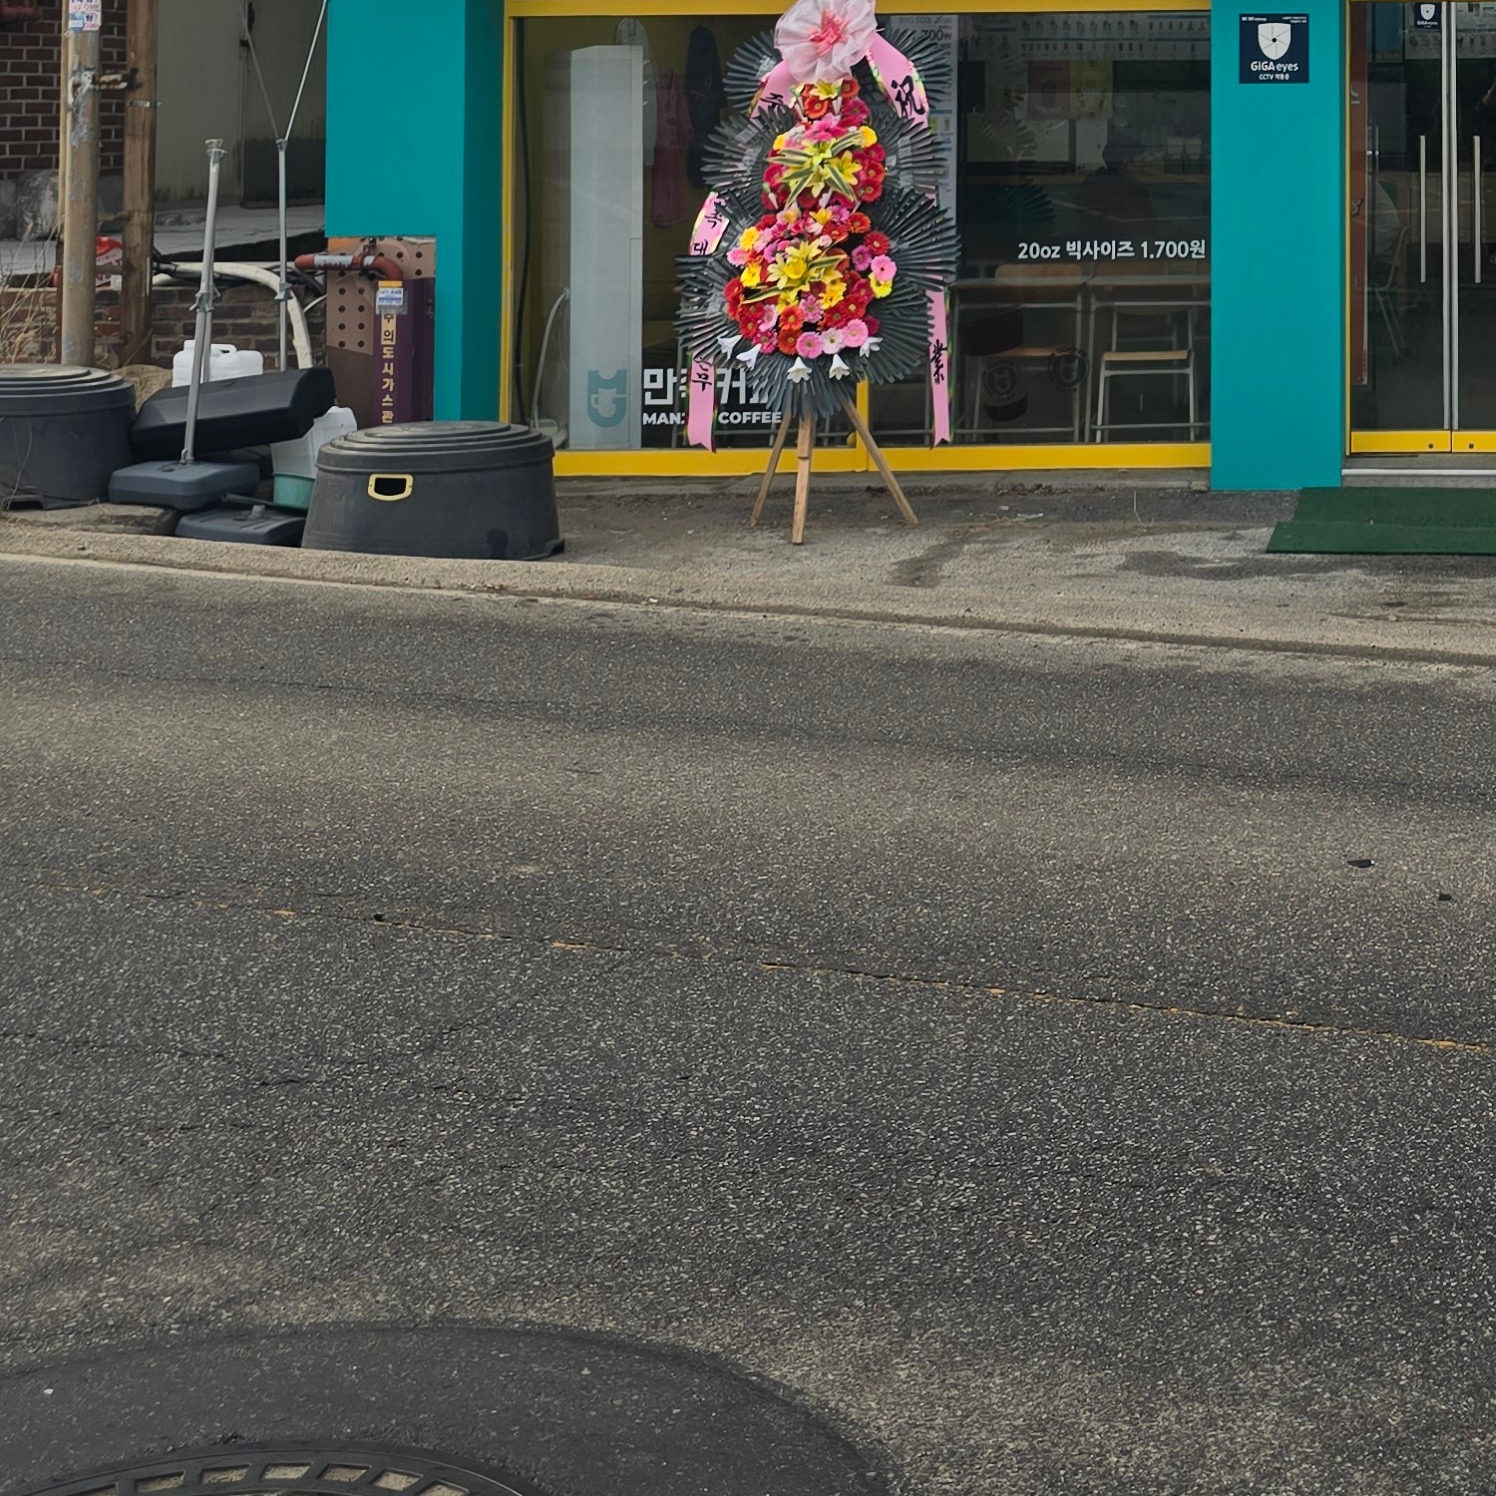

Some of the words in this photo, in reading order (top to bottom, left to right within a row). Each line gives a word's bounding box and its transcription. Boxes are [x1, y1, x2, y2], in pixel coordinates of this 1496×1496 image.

[1018, 243, 1061, 259] 20oz
[1066, 240, 1136, 260] 빅사이즈
[643, 368, 769, 405] 만커
[718, 411, 783, 424] COFFEE
